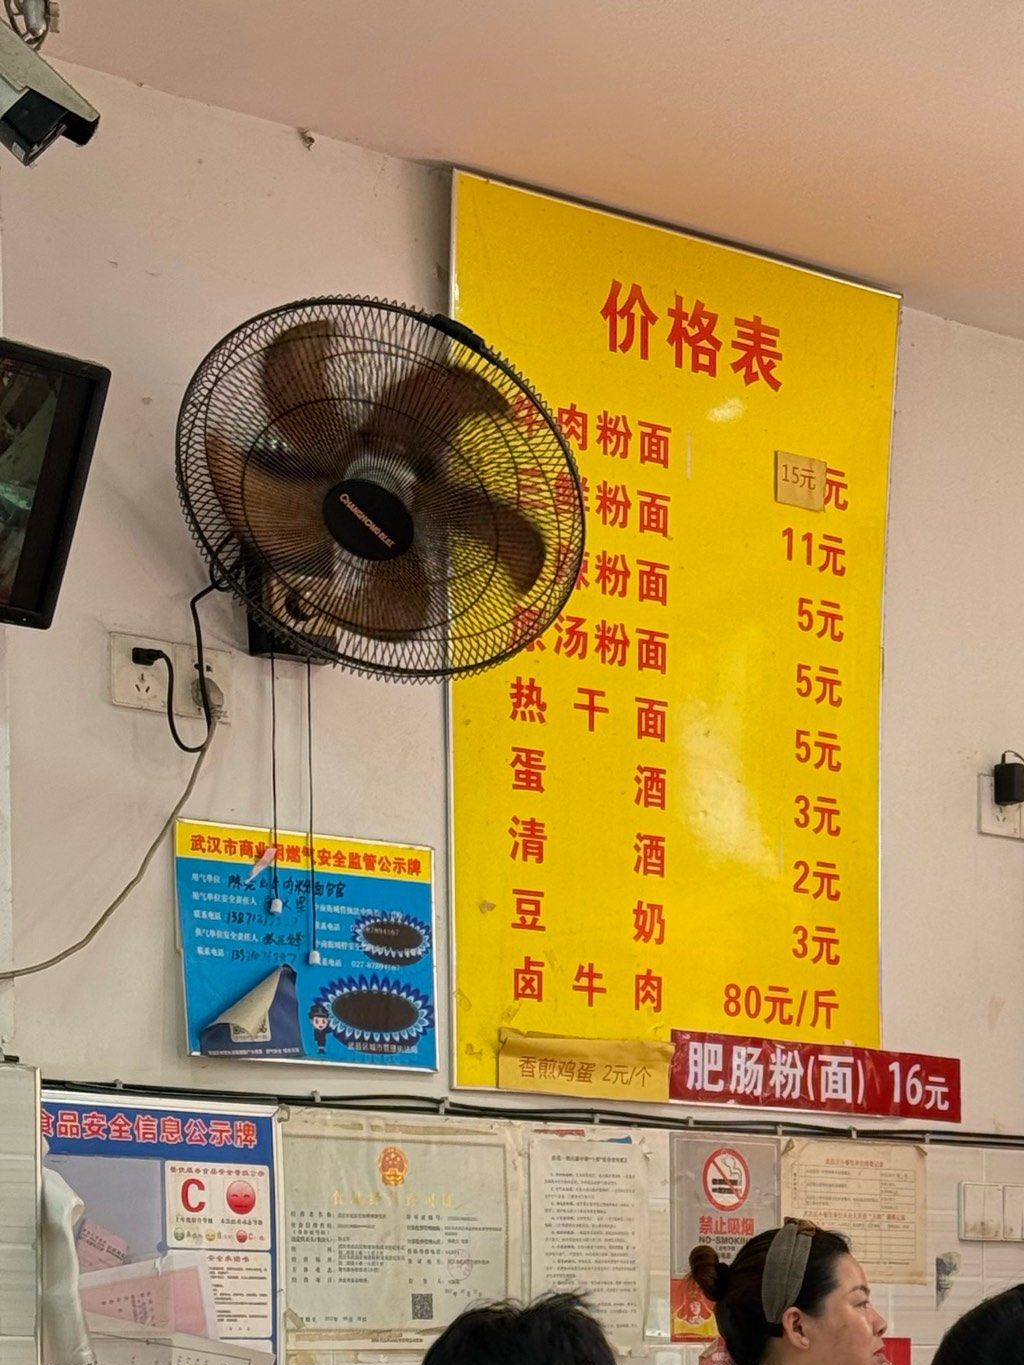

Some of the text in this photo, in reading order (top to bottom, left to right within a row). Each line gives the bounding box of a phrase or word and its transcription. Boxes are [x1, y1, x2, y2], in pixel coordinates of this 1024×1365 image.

[600, 279, 784, 392] 价格表
[781, 463, 817, 491] 15元
[782, 527, 846, 577] 11元
[797, 598, 844, 642] 5元
[796, 664, 843, 707] 5元
[509, 676, 842, 773] 热干面 5元
[794, 795, 841, 838] 3元
[190, 833, 422, 877] 武汉市商业用燃气安全监管公示牌
[793, 860, 841, 902] 2元
[792, 926, 840, 966] 3元
[513, 956, 839, 1030] 卤牛肉 80元/斤
[518, 1055, 653, 1088] 香煎鸡蛋 2元/个
[686, 1041, 950, 1111] 肥肠粉(面) 16元
[41, 1109, 257, 1148] 食品安全信息公示牌
[181, 1178, 206, 1213] C
[699, 1215, 754, 1236] 禁止吸烟
